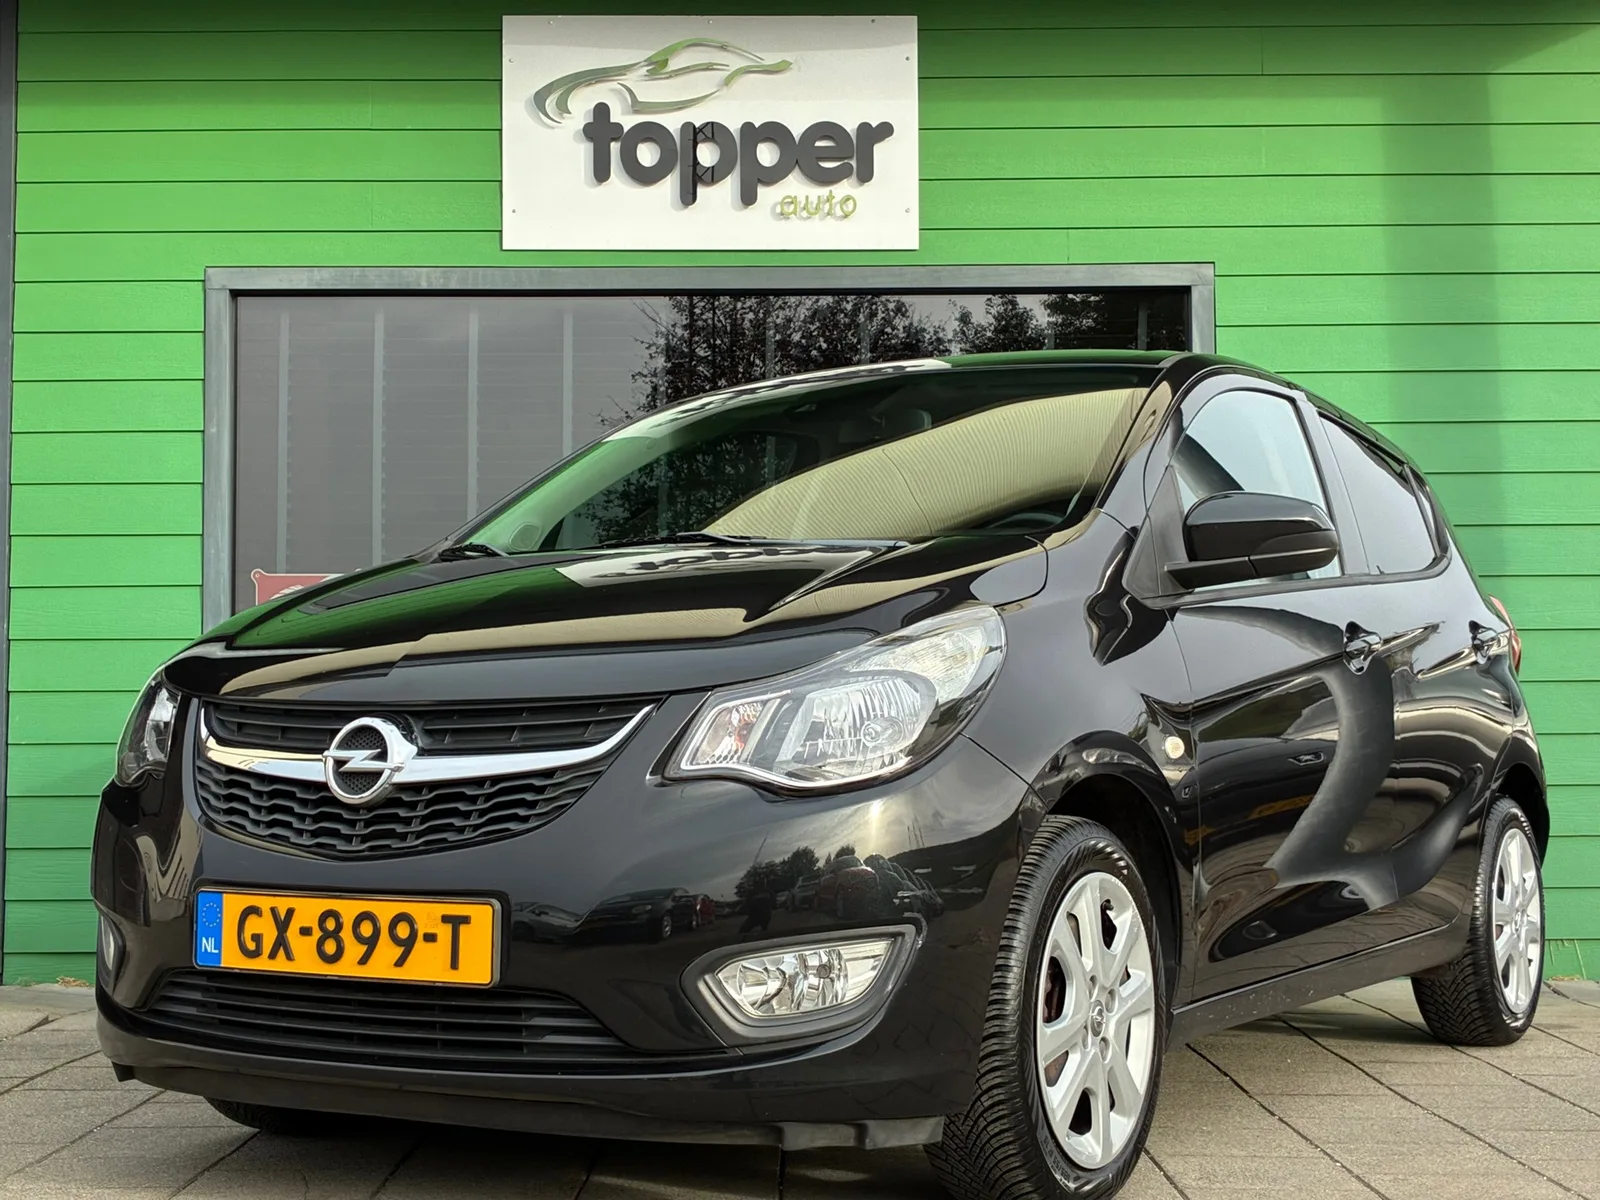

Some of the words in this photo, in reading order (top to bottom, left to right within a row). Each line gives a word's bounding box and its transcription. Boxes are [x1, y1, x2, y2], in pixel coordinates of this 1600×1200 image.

[582, 102, 894, 206] topper
[780, 189, 857, 217] auto
[201, 936, 219, 953] NL
[237, 905, 472, 970] GX-899-T
